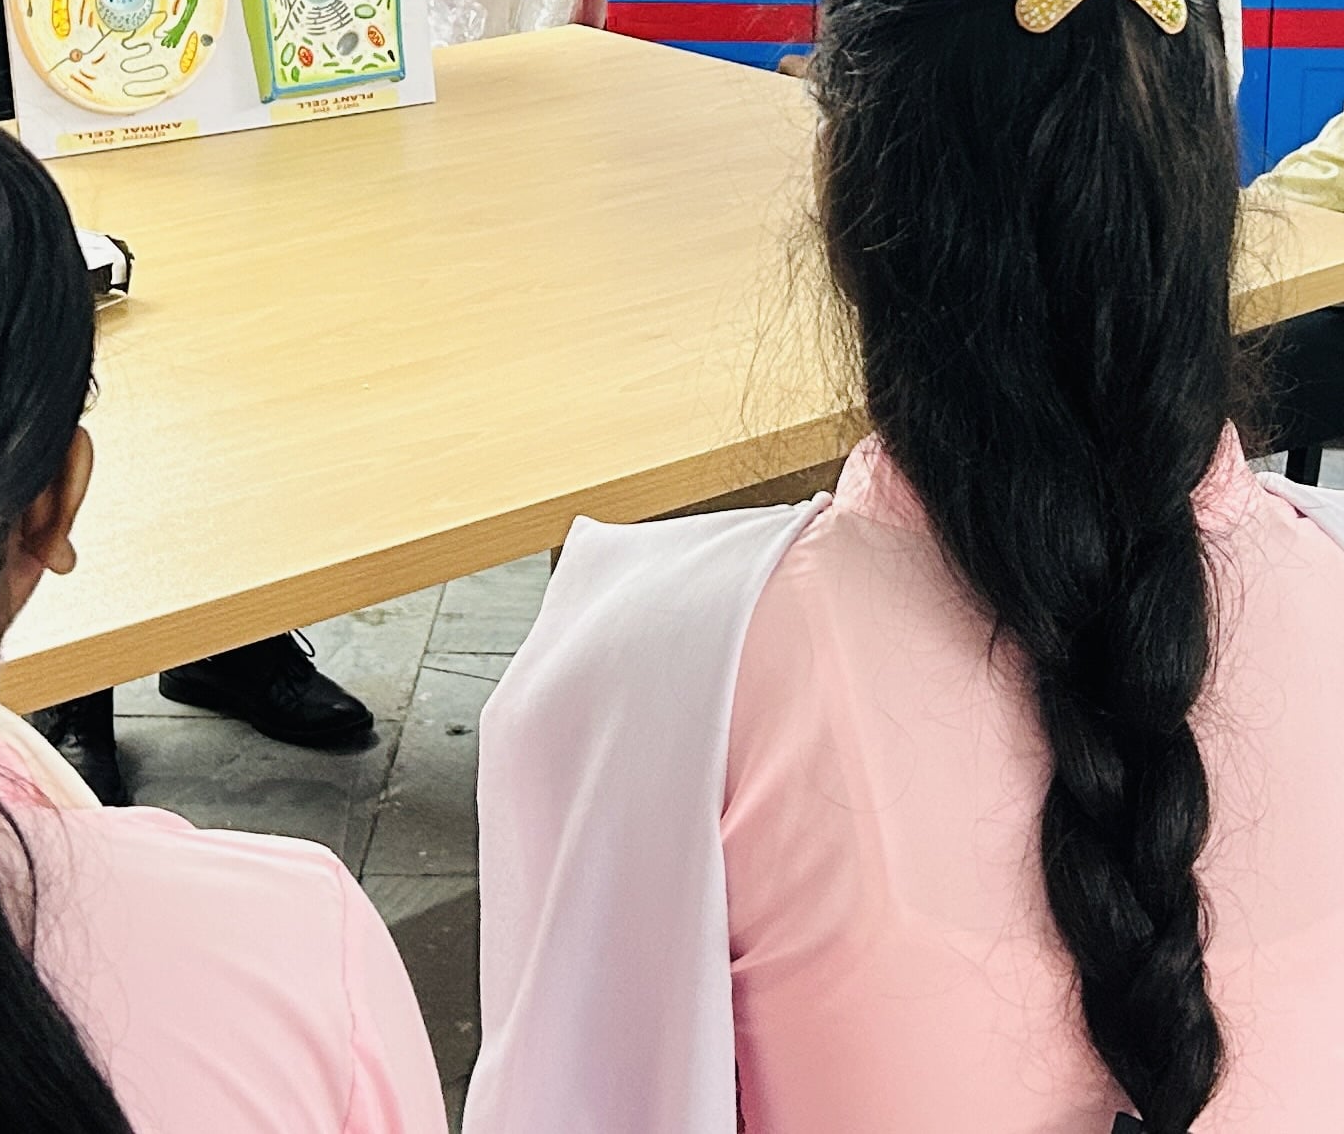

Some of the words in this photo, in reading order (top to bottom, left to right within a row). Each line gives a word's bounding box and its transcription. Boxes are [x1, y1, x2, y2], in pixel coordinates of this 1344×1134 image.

[298, 99, 329, 109] CELL
[333, 92, 374, 105] PLANT
[121, 122, 182, 134] ANIMAL
[74, 130, 115, 140] CELL
